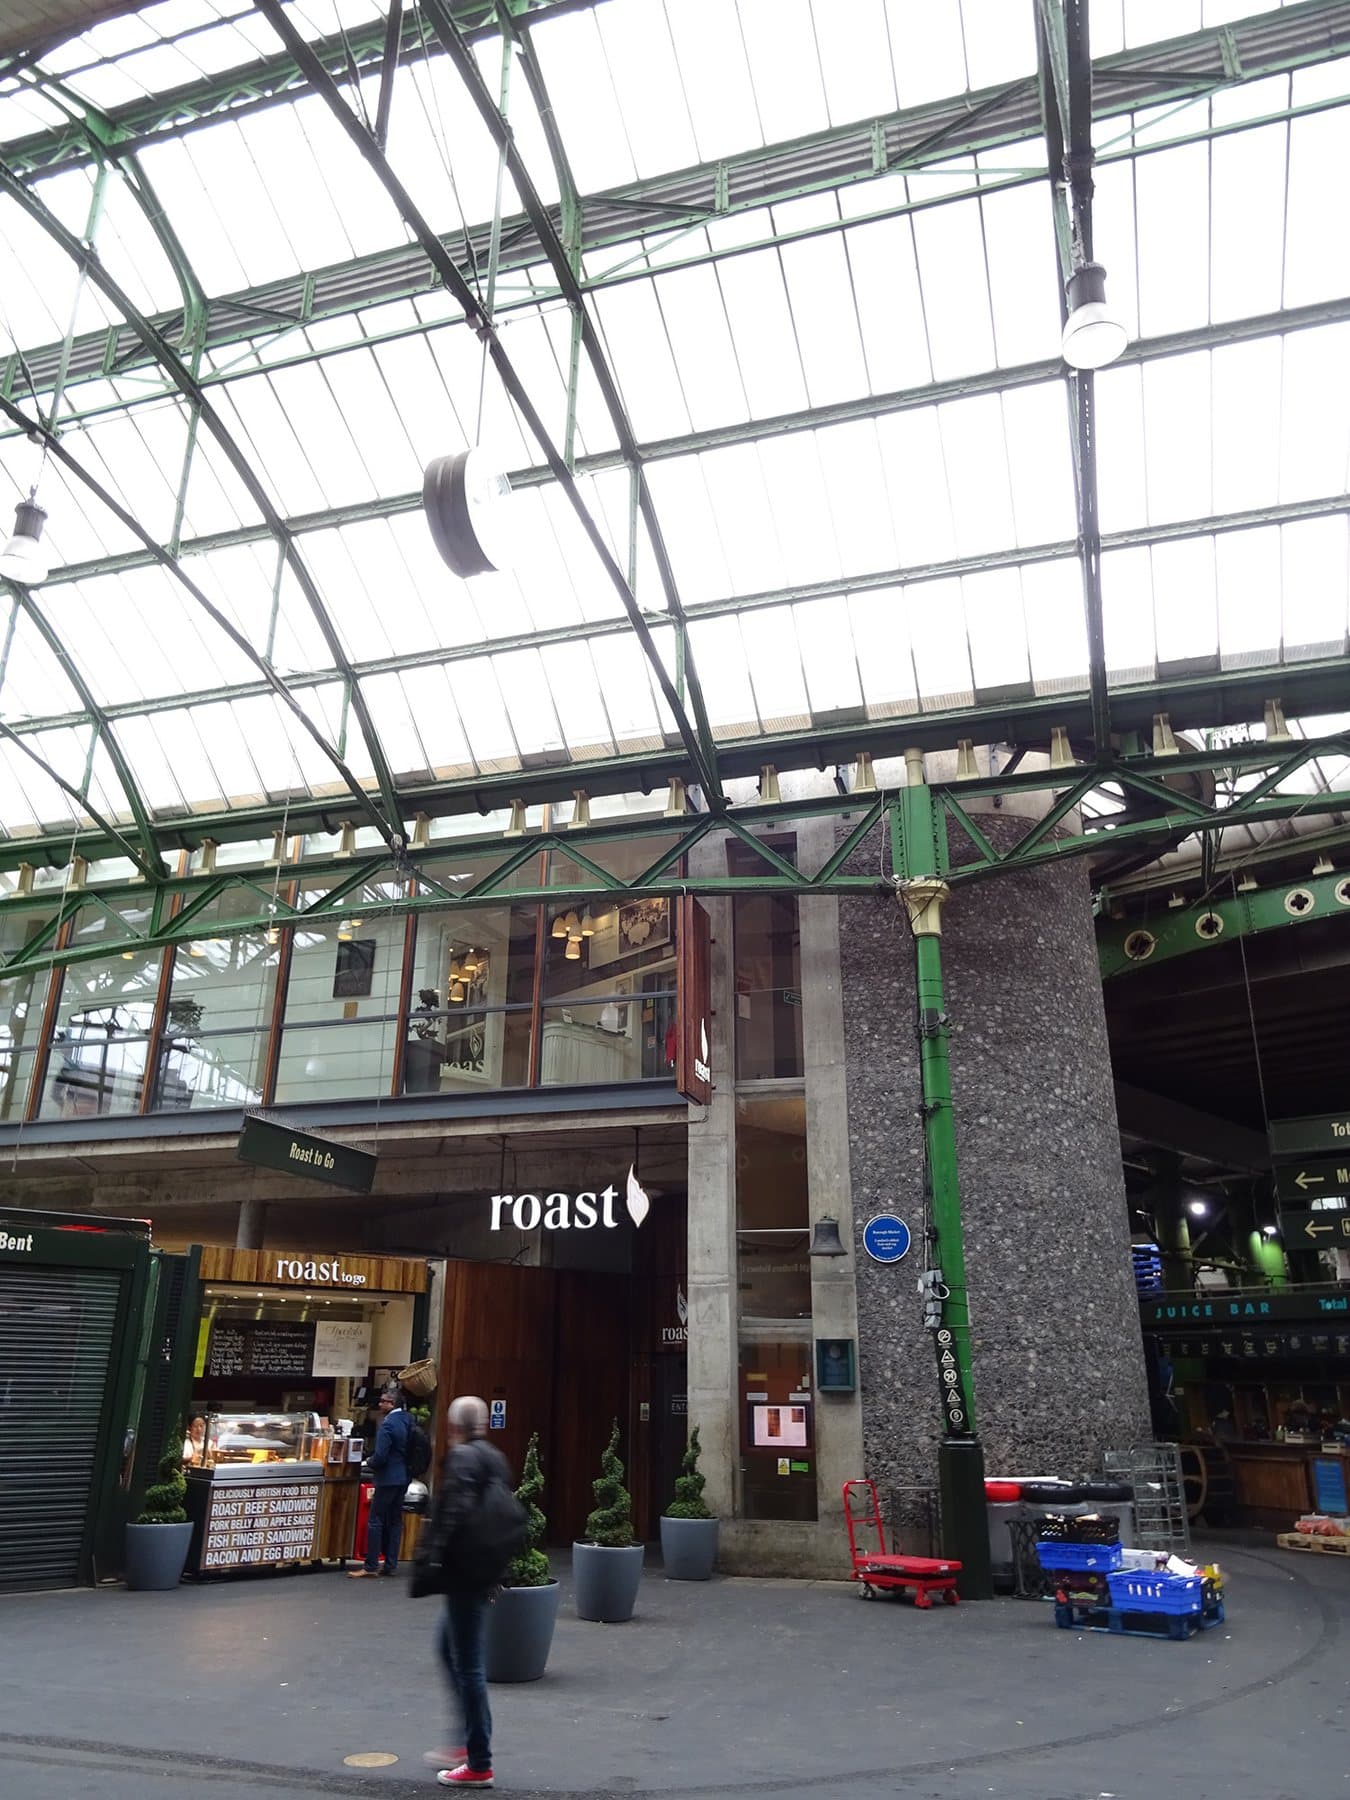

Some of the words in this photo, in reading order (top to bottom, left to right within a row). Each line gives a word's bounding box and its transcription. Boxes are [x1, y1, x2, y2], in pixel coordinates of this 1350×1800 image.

[290, 1142, 313, 1163] Roast
[314, 1150, 323, 1166] to
[324, 1152, 335, 1169] Go
[490, 1184, 619, 1230] roast
[277, 1259, 340, 1281] roast
[1155, 1304, 1213, 1319] JUICE
[1230, 1302, 1271, 1315] BAR
[1318, 1296, 1347, 1310] Total
[213, 1489, 255, 1500] DELICIOUSLY
[255, 1487, 281, 1497] BRITISH
[282, 1486, 299, 1496] FOOD
[300, 1486, 309, 1495] TO
[309, 1485, 319, 1495] GO
[211, 1502, 243, 1516] ROAST
[244, 1501, 268, 1514] BEEF
[269, 1499, 317, 1513] SANDWICH
[209, 1520, 230, 1531] PORK
[230, 1518, 253, 1529] BELLY
[253, 1517, 269, 1528] AND
[270, 1516, 293, 1526] APPLE
[293, 1515, 315, 1525] SAUCE
[207, 1534, 229, 1548] FISH
[231, 1532, 265, 1546] FINGER
[266, 1528, 314, 1543] SANDWICH
[205, 1550, 240, 1565] BACON
[240, 1548, 261, 1562] AND
[263, 1547, 282, 1560] EGG
[283, 1544, 313, 1558] BUTTY
